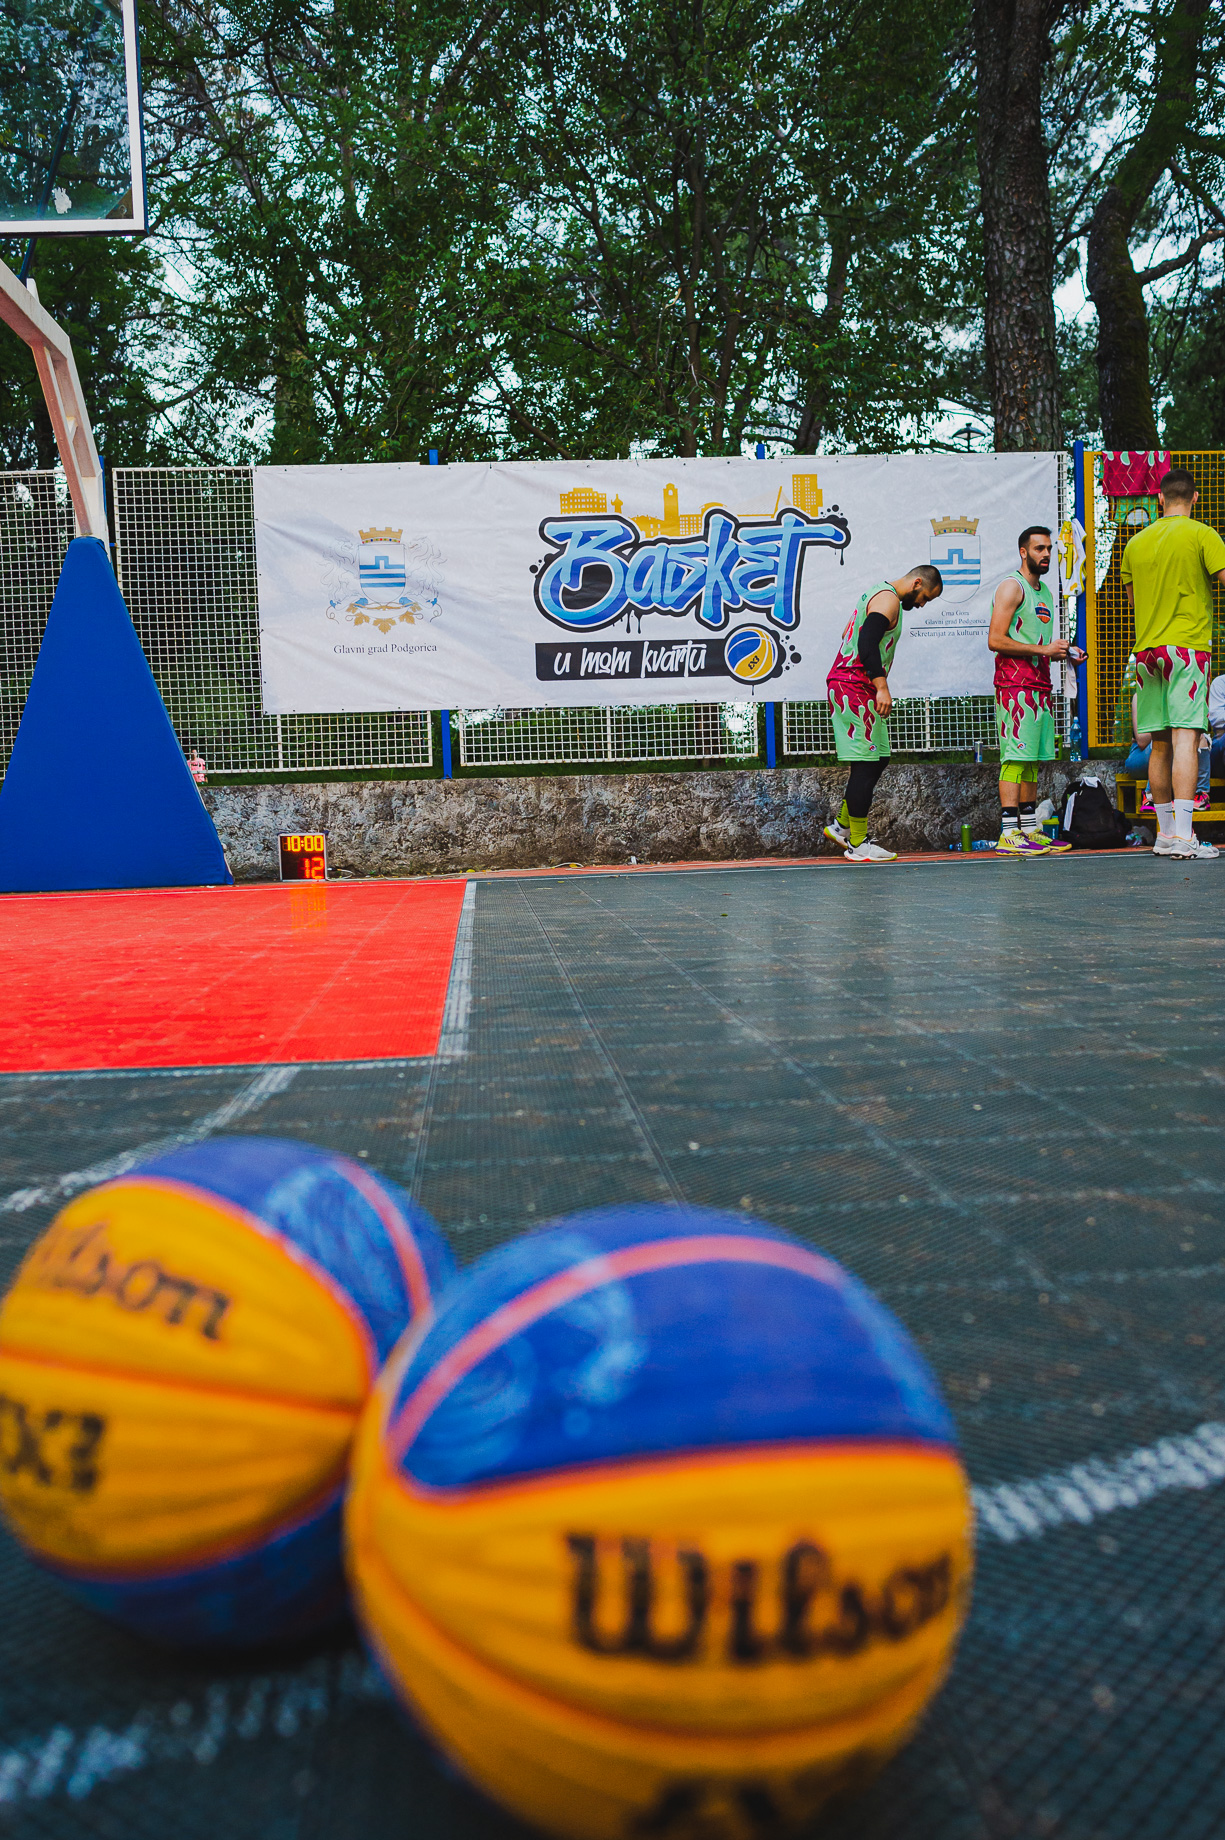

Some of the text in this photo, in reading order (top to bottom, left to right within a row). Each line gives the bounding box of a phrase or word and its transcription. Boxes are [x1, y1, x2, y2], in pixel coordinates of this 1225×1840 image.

[944, 618, 957, 626] grad
[333, 643, 437, 655] Glavni grad Podgorica
[553, 652, 572, 676] u
[640, 640, 707, 679] kvartu
[286, 835, 324, 852] 10:00
[304, 856, 325, 880] 12
